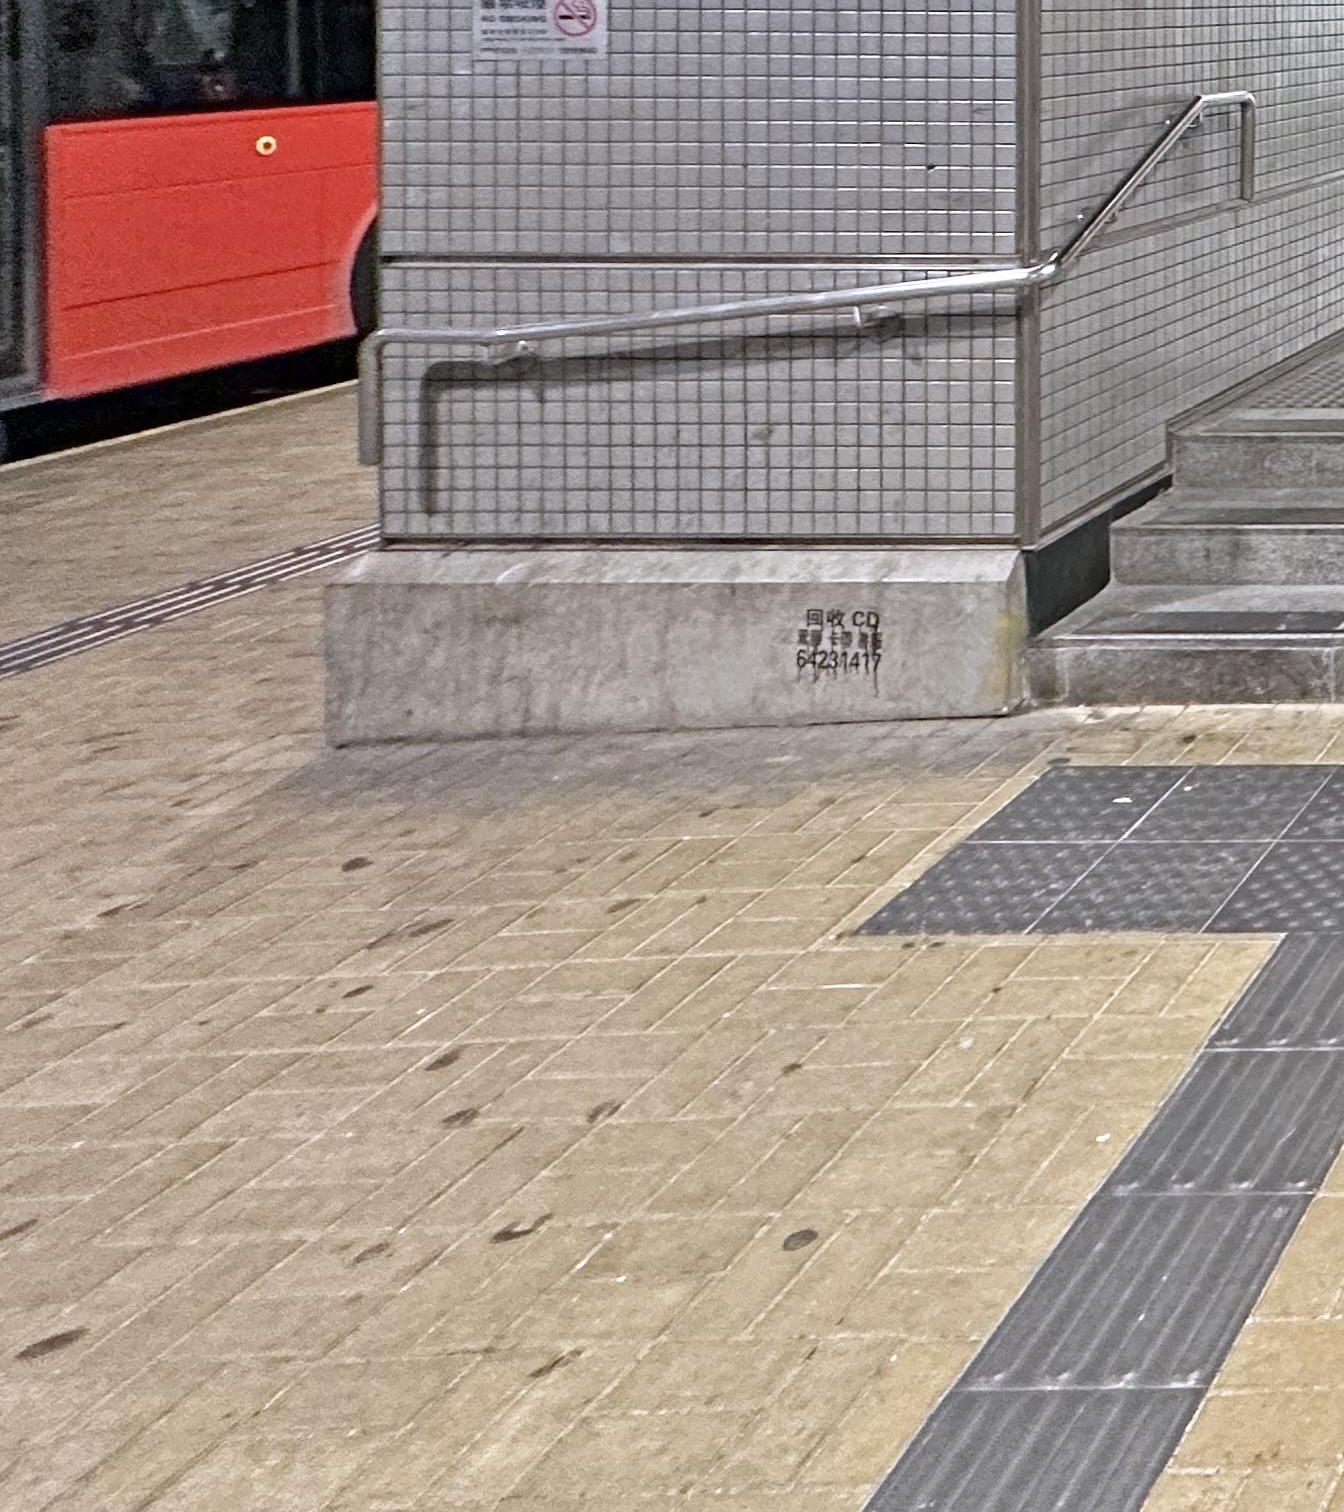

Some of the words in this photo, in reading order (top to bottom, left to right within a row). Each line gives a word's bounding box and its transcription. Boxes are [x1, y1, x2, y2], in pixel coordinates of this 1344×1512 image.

[806, 609, 845, 629] 回收
[852, 611, 880, 628] CD
[796, 649, 882, 673] 64231417
